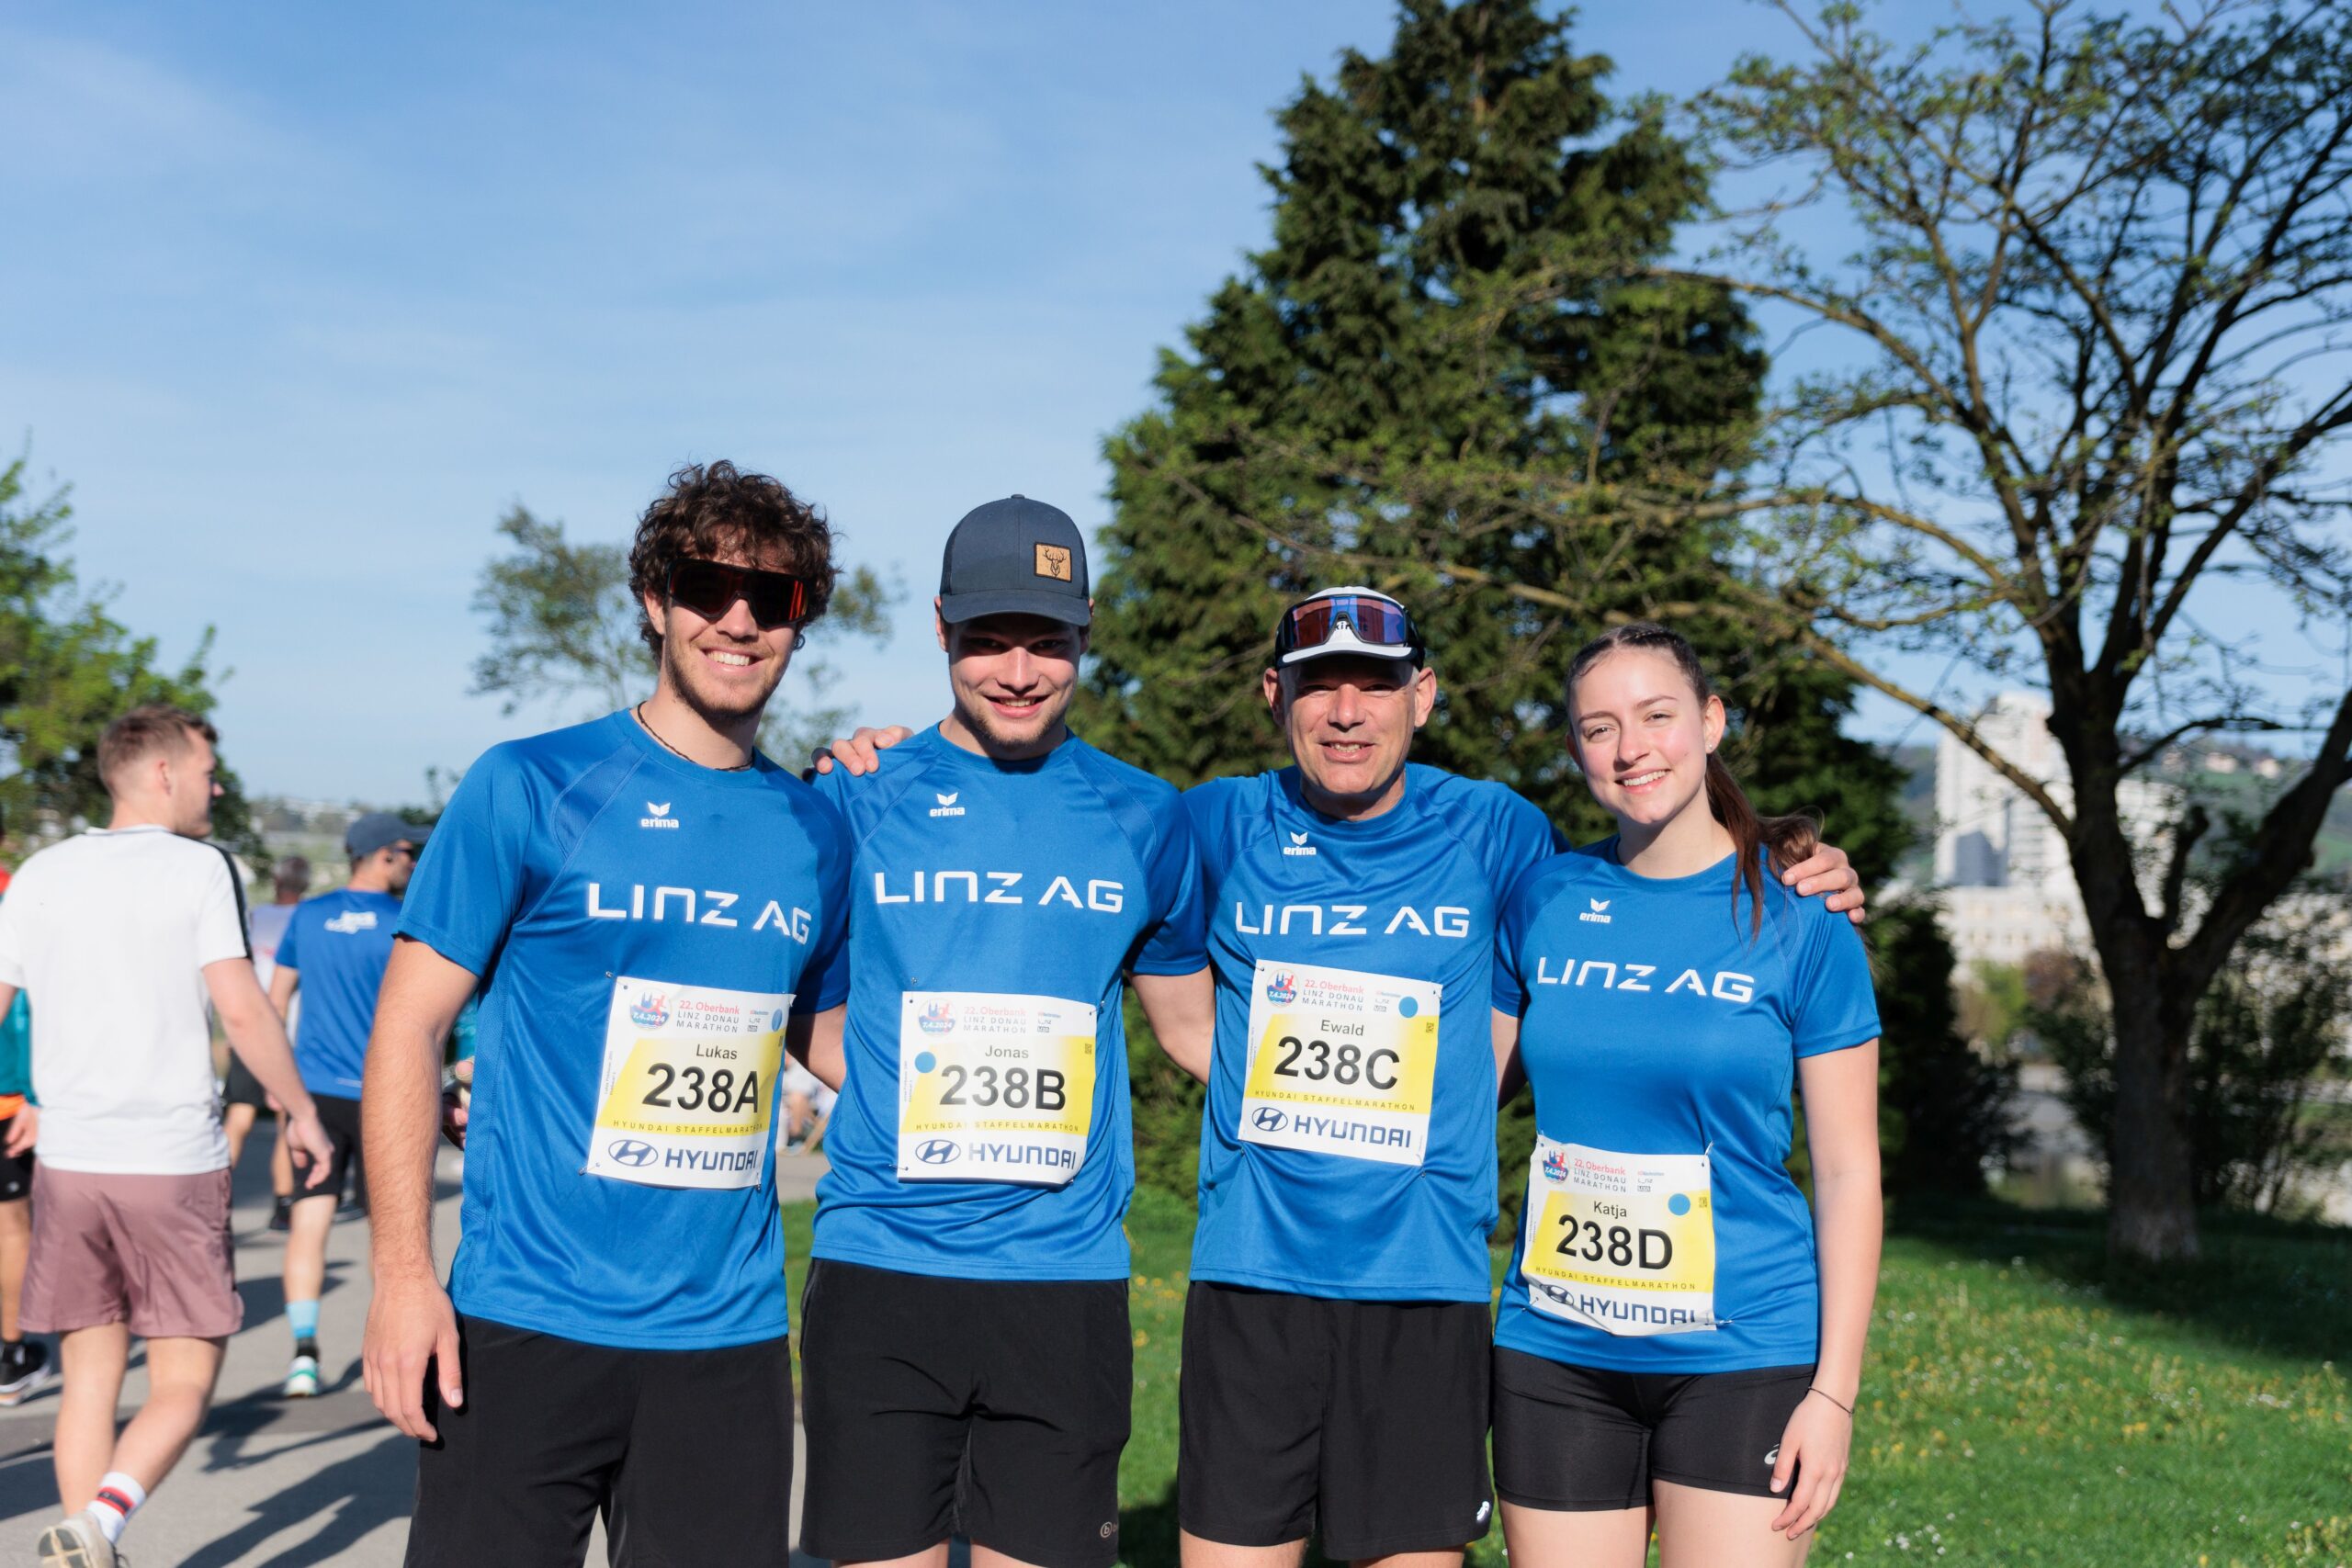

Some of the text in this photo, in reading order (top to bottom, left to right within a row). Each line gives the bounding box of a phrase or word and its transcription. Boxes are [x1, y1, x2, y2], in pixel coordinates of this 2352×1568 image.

[930, 807, 965, 818] erima
[641, 818, 679, 829] erima
[1283, 846, 1317, 856] erima
[875, 871, 1124, 913] LINZ AG
[589, 883, 811, 945] LINZ AG
[1235, 902, 1470, 938] LINZ AG
[1579, 912, 1611, 924] erima
[1305, 979, 1364, 994] 22. Oberbank
[1537, 956, 1755, 1004] LINZ AG
[1304, 989, 1363, 1003] LINZ DONAU
[680, 1000, 693, 1010] 22.
[695, 1001, 740, 1015] Oberbank
[965, 1007, 1025, 1016] 22. Oberbank
[1302, 998, 1363, 1011] MARATHON
[677, 1011, 699, 1021] LINZ
[705, 1014, 740, 1024] DONAU
[964, 1016, 1026, 1025] LINZ DONAU
[676, 1020, 738, 1032] MARATHON
[964, 1025, 1026, 1034] MARATHON
[1320, 1020, 1364, 1036] Ewald
[695, 1043, 738, 1059] Lukas
[985, 1045, 1029, 1059] Jonas
[1273, 1036, 1400, 1089] 238C
[641, 1063, 758, 1113] 238A
[939, 1065, 1066, 1111] 238B
[1255, 1090, 1415, 1111] HYUNDAI STAFFELMARATHON
[613, 1120, 763, 1134] HYUNDAI STAFFELMARATHON
[975, 1122, 1079, 1132] STAFFELMARATHON
[1294, 1114, 1411, 1147] HYUNDAI
[665, 1148, 757, 1170] HYUNDAI
[968, 1143, 1076, 1169] HYUNDAI
[1574, 1158, 1585, 1168] 22.
[1586, 1160, 1626, 1176] Oberbank
[1574, 1168, 1591, 1178] LINZ
[1593, 1172, 1626, 1184] DONAU
[1573, 1177, 1626, 1193] MARATHON
[1593, 1201, 1627, 1219] Katja
[1556, 1214, 1673, 1270] 238D
[1535, 1266, 1696, 1290] HYUNDAI STAFFELMARATHON
[1580, 1294, 1695, 1325] HYUNDAI
